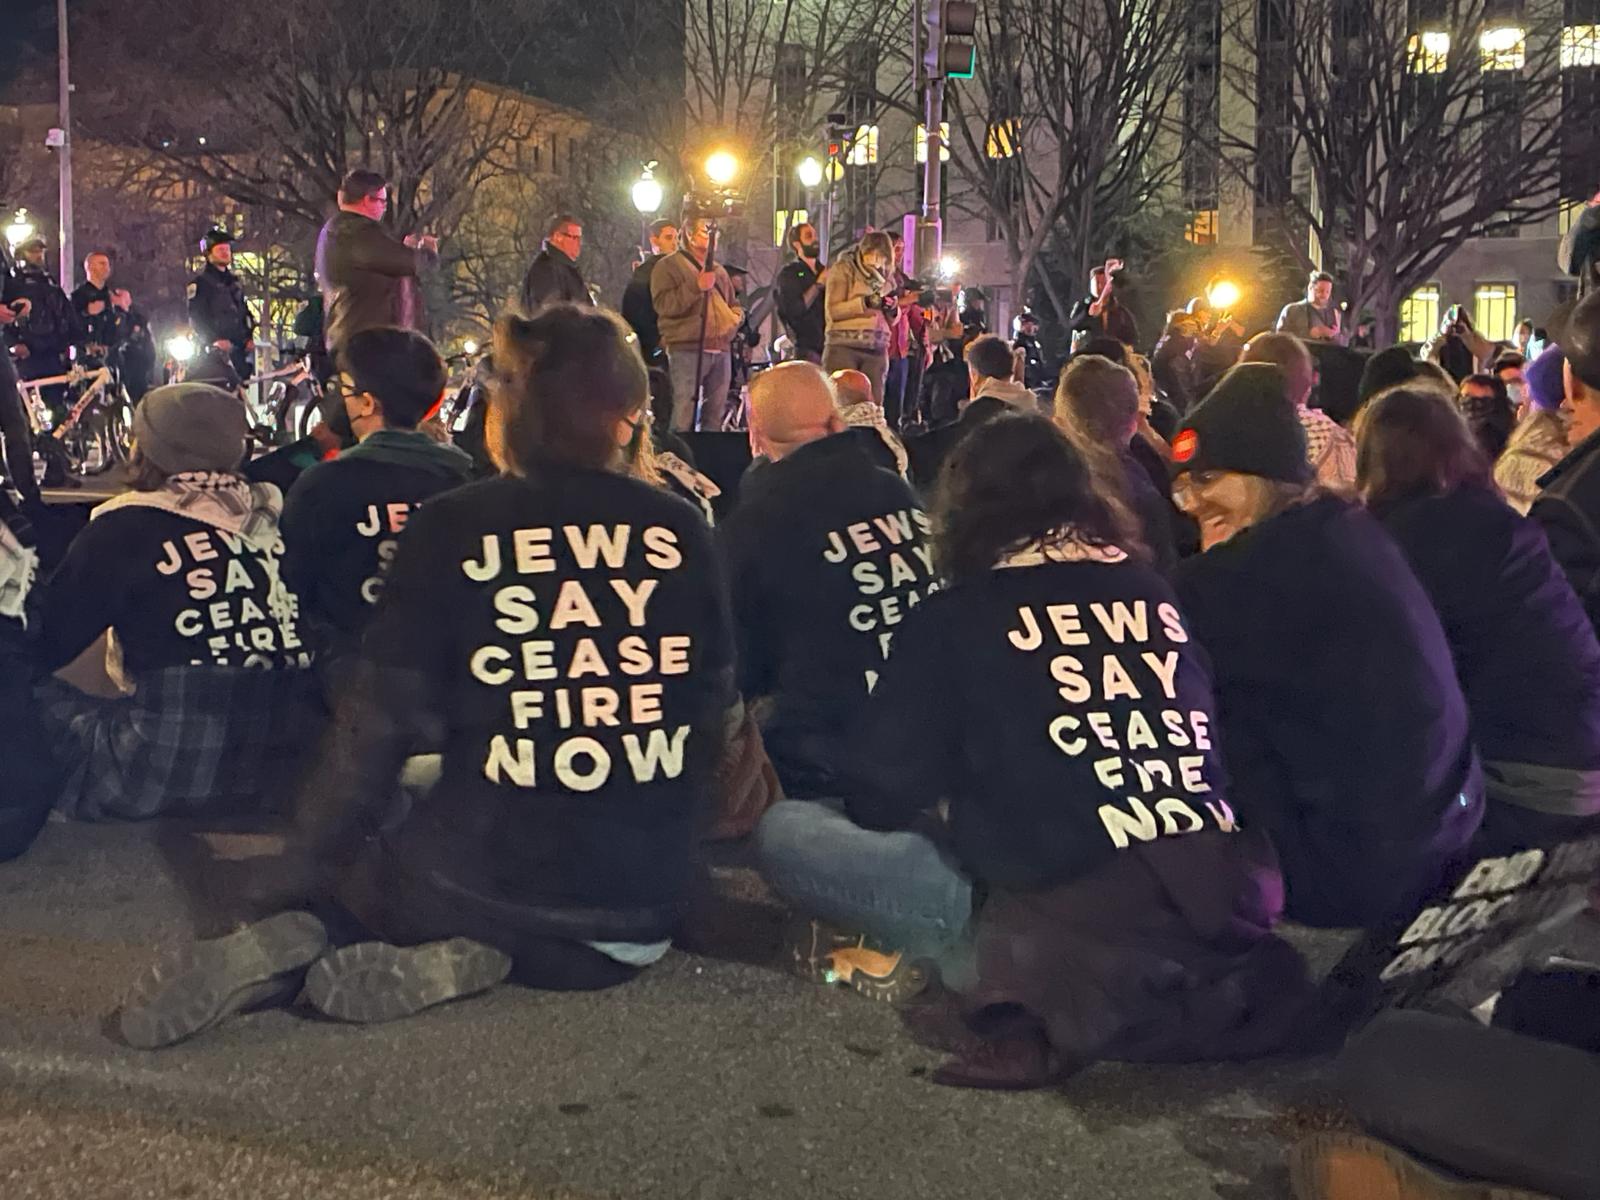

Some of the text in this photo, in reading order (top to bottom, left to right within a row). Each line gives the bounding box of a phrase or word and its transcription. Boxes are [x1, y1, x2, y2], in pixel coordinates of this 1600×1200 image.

[462, 524, 683, 581] JEWS
[823, 508, 933, 563] JEWS
[852, 543, 935, 595] SAY
[494, 579, 659, 634] SAY
[1007, 600, 1188, 651] JEWS
[470, 636, 691, 685] CEASE
[1050, 651, 1179, 703] SAY
[510, 684, 664, 729] FIRE
[484, 725, 691, 791] NOW
[1048, 710, 1212, 756] CEASE
